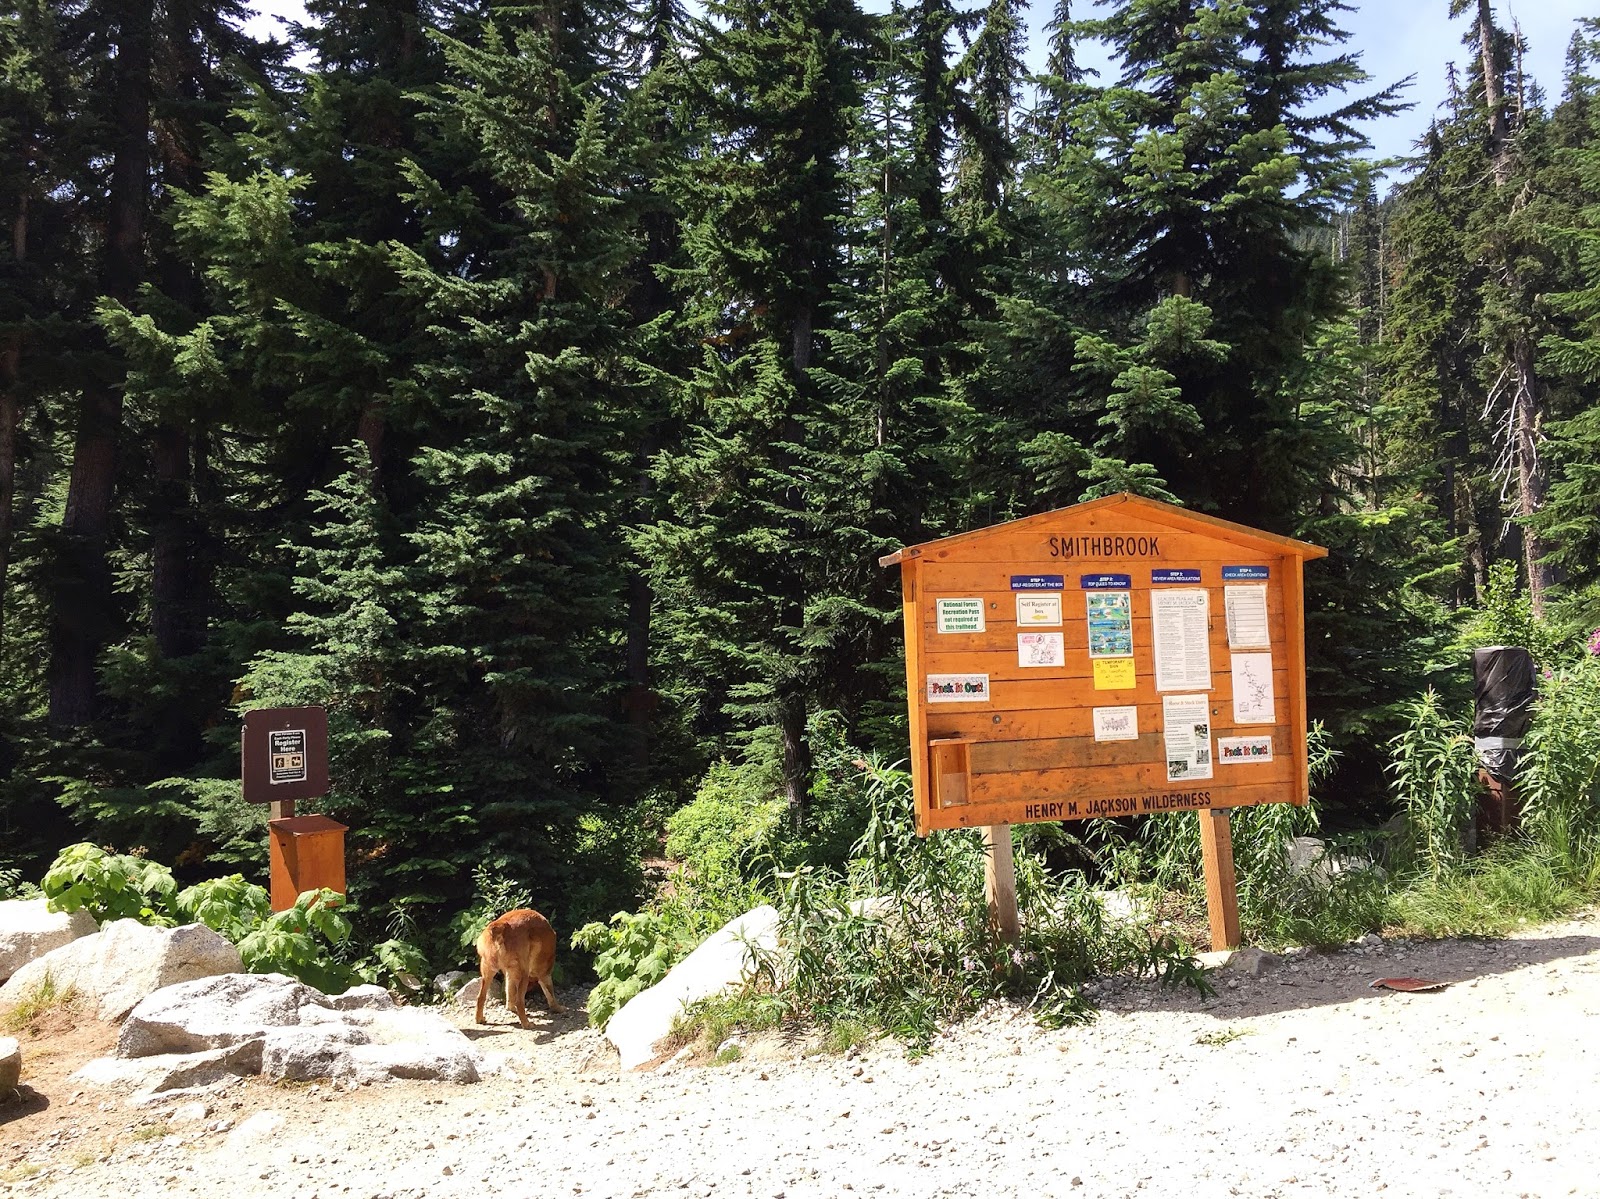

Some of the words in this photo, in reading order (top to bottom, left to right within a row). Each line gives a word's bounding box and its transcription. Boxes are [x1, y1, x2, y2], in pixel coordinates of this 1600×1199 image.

[1049, 536, 1159, 556] SMITHBROOK
[932, 682, 954, 694] Pack
[954, 682, 964, 693] It
[964, 682, 984, 693] Out!
[1224, 746, 1242, 757] Pack
[1243, 745, 1250, 756] It
[1251, 744, 1268, 756] Out!
[1026, 803, 1064, 818] HENRY
[1068, 802, 1082, 816] M.
[1086, 798, 1137, 815] JACKSON
[1142, 792, 1211, 810] WILDERNESS
